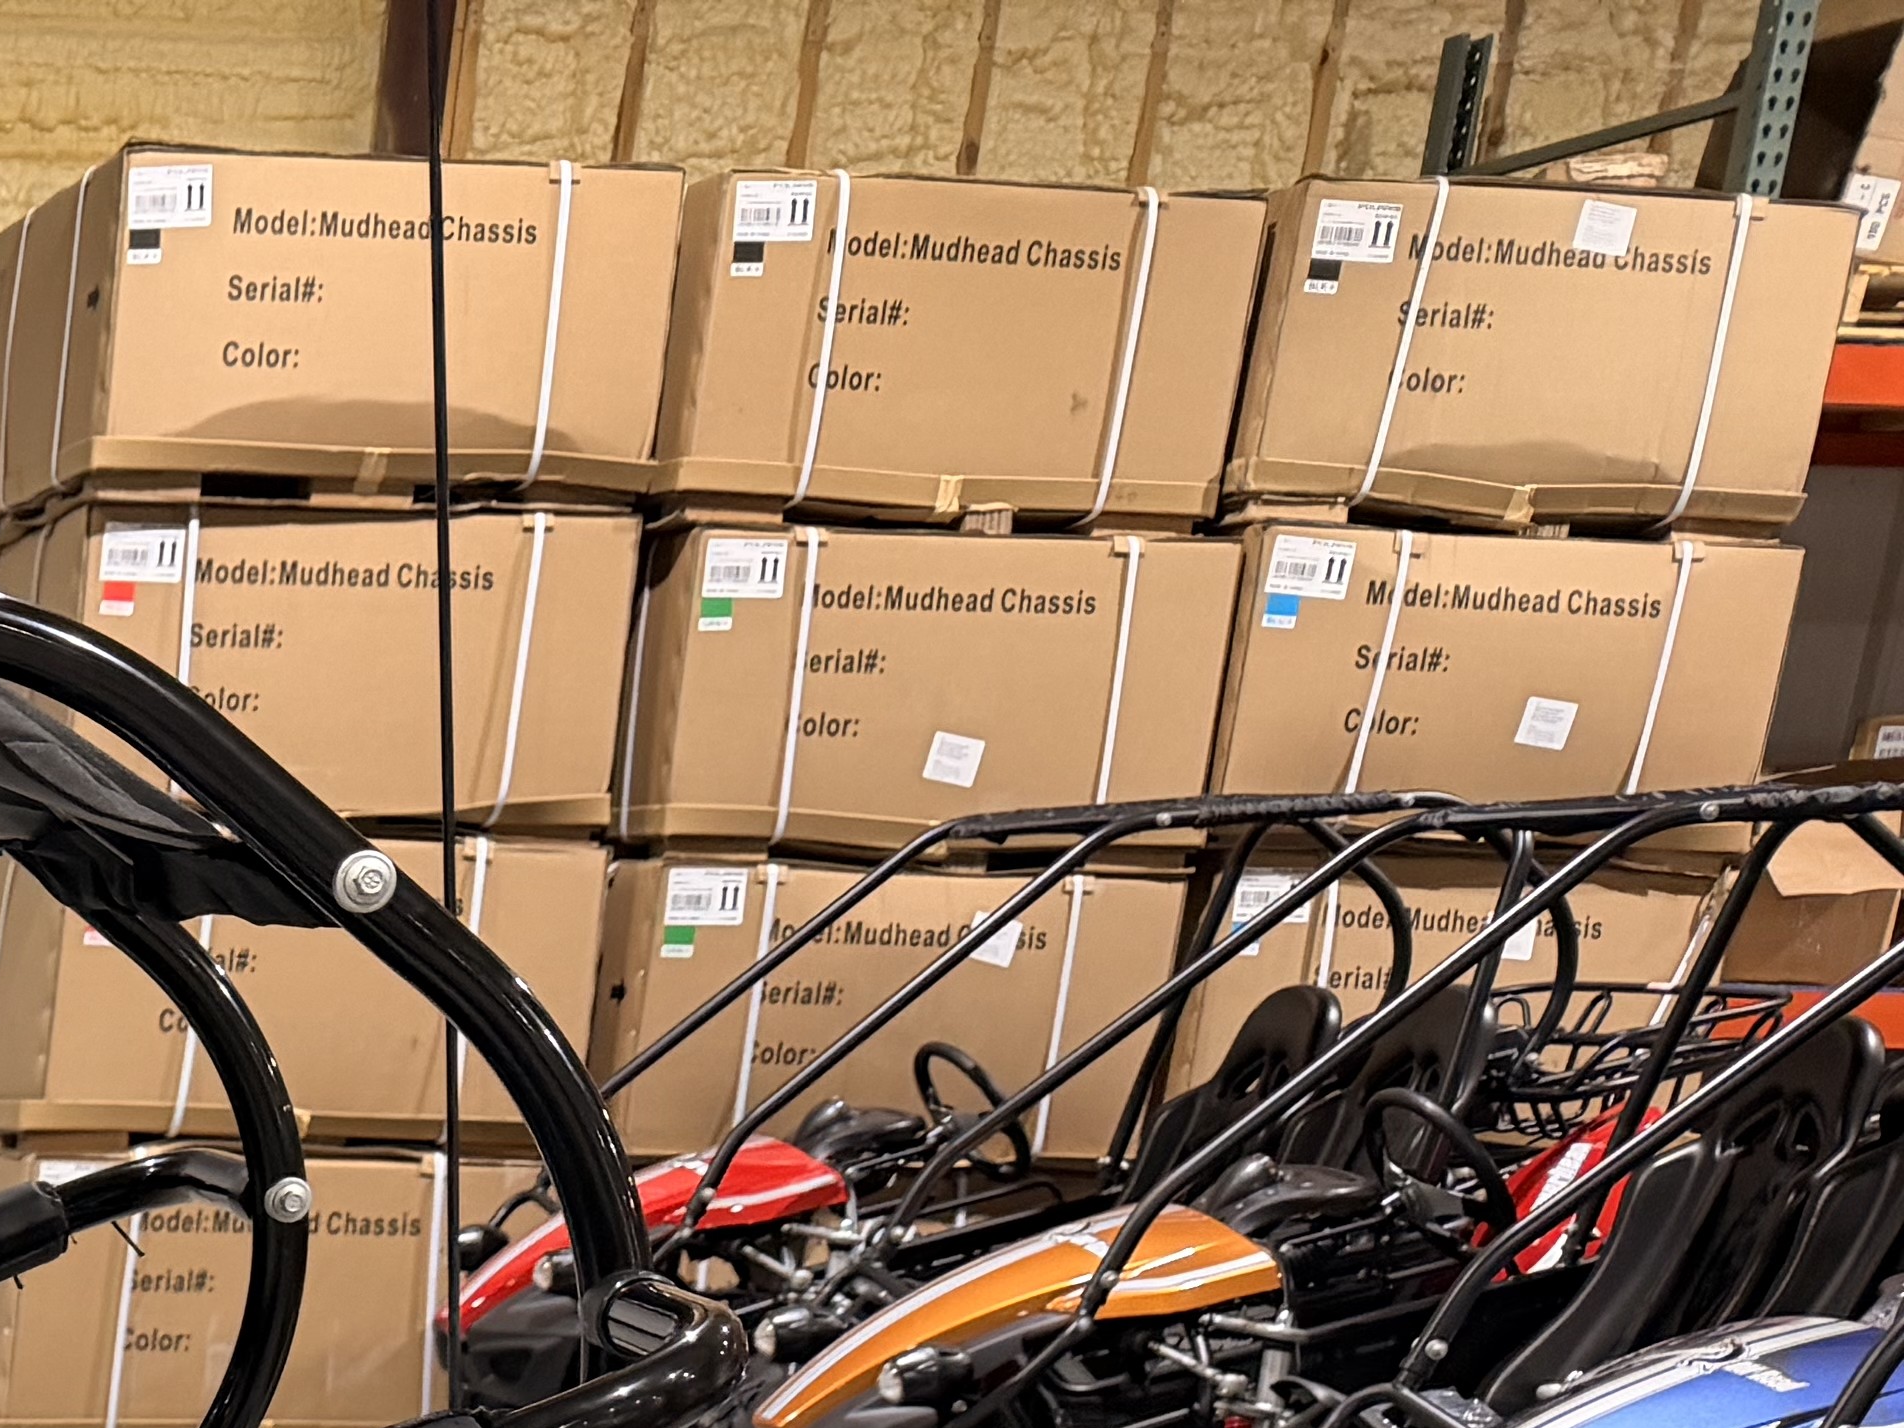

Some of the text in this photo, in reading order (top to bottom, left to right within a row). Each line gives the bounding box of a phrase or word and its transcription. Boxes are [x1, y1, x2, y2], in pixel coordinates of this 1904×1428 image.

[441, 216, 538, 245] Chassis
[1028, 242, 1122, 272] Chassis
[227, 274, 324, 303] Serial#:
[221, 341, 300, 369] Color:
[1001, 588, 1097, 616] Chassis
[1567, 589, 1662, 620] Chassis
[190, 623, 283, 650] Serial#:
[804, 648, 887, 675] erial#:
[797, 712, 860, 738] olor:
[1344, 707, 1420, 736] Clor:
[326, 1211, 422, 1238] Chassis
